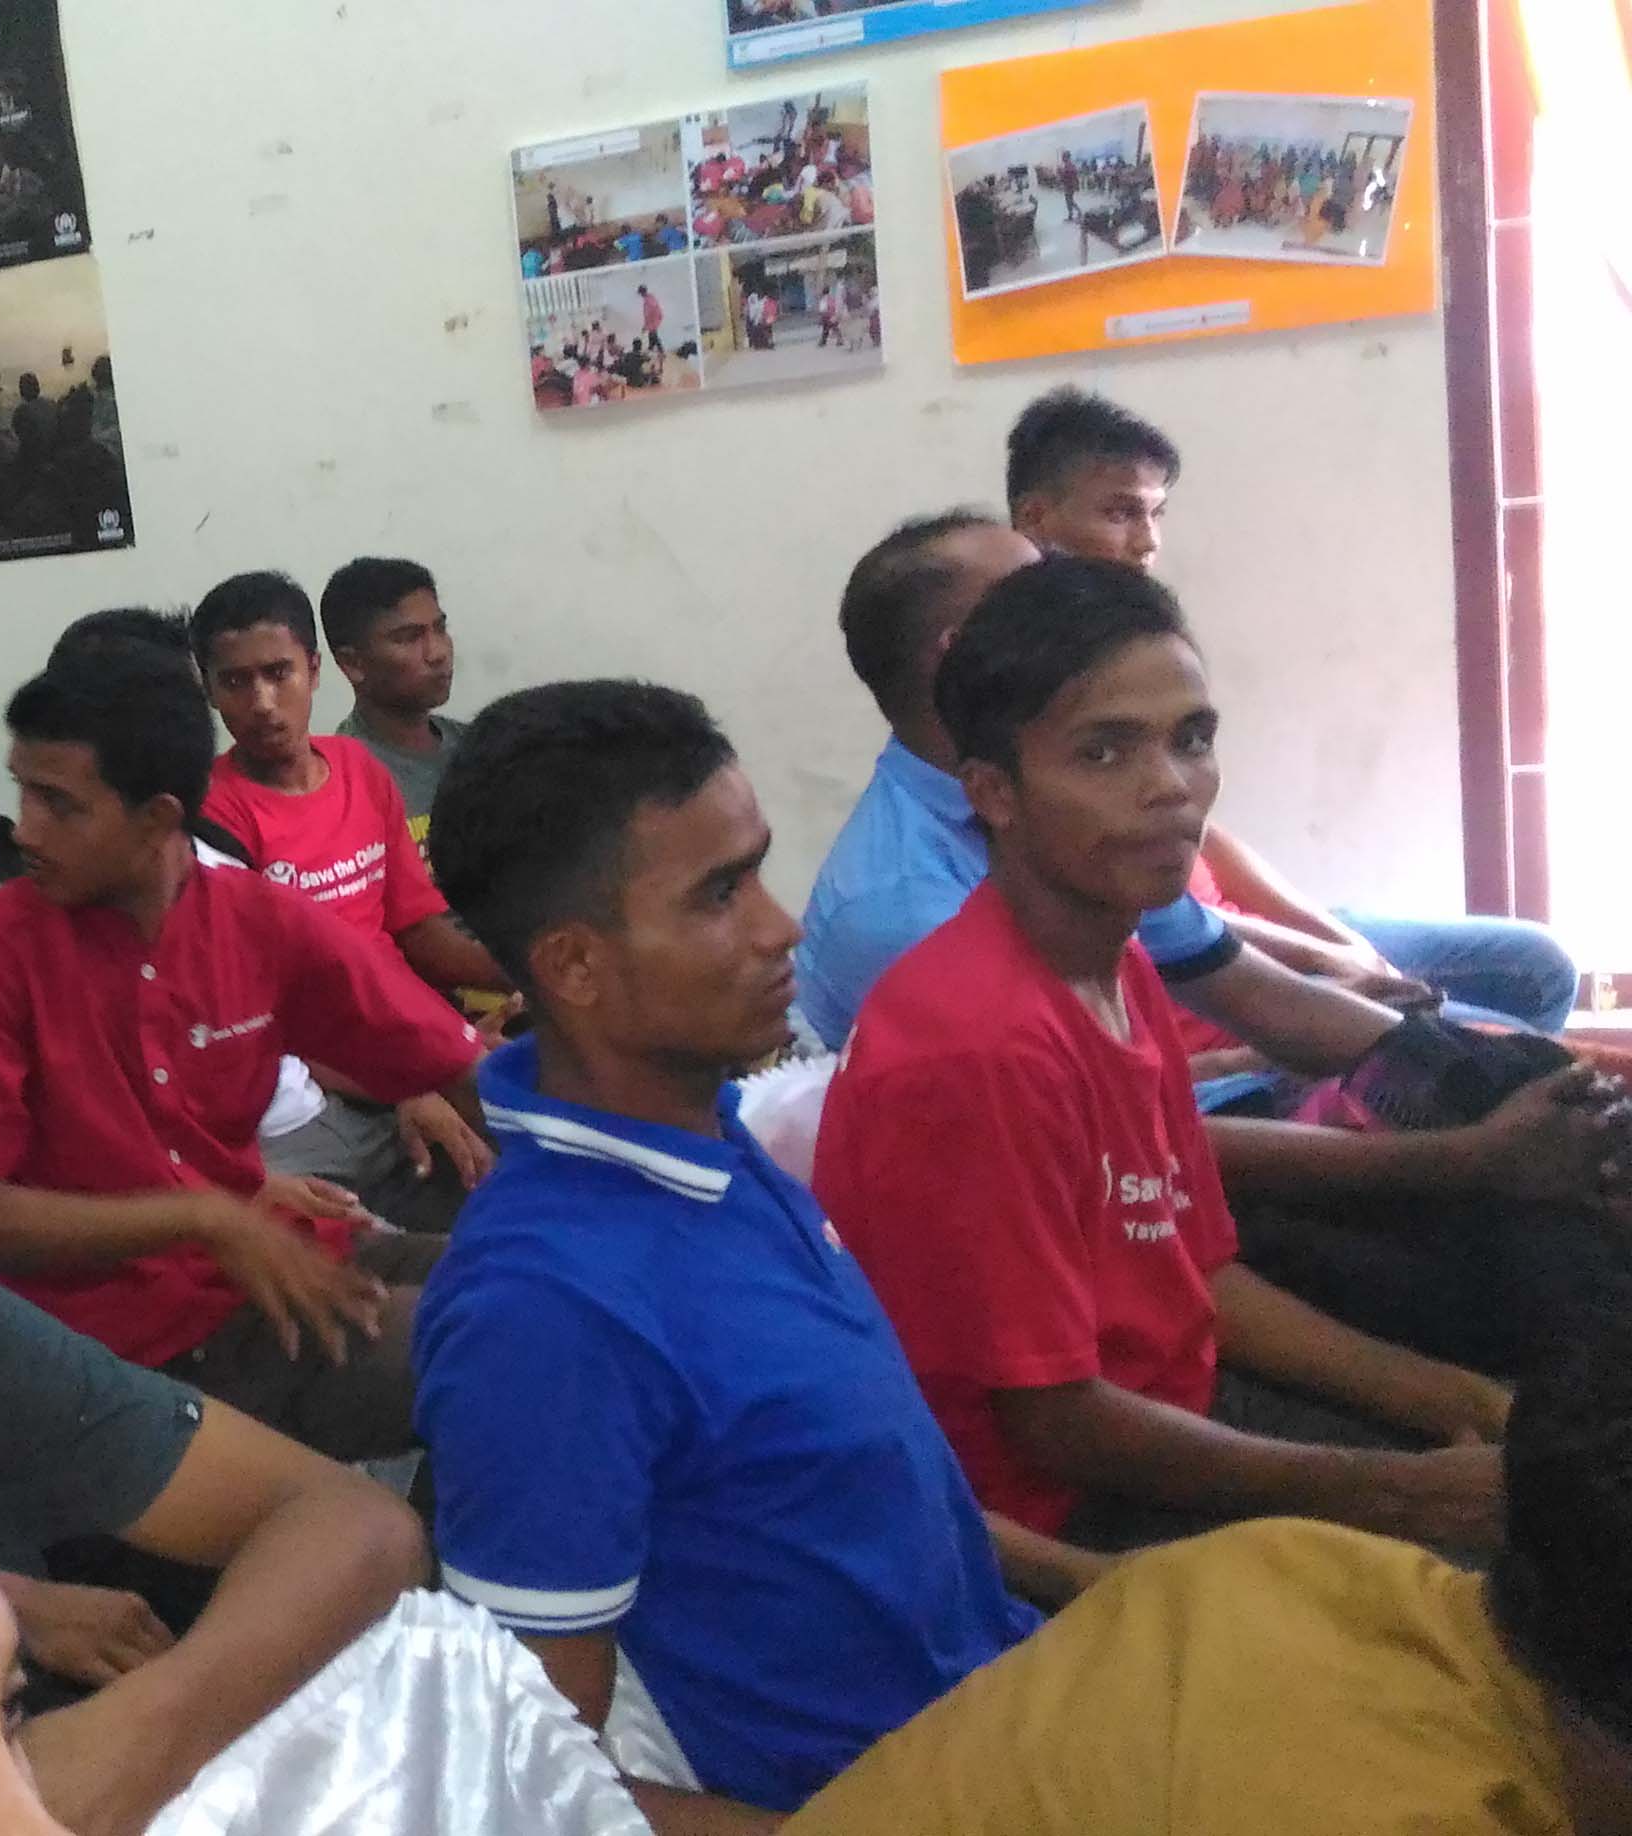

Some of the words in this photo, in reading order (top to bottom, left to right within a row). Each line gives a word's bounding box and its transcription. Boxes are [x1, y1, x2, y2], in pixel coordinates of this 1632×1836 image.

[299, 867, 335, 889] Save
[333, 859, 357, 879] the
[1123, 1220, 1177, 1243] Yaya
